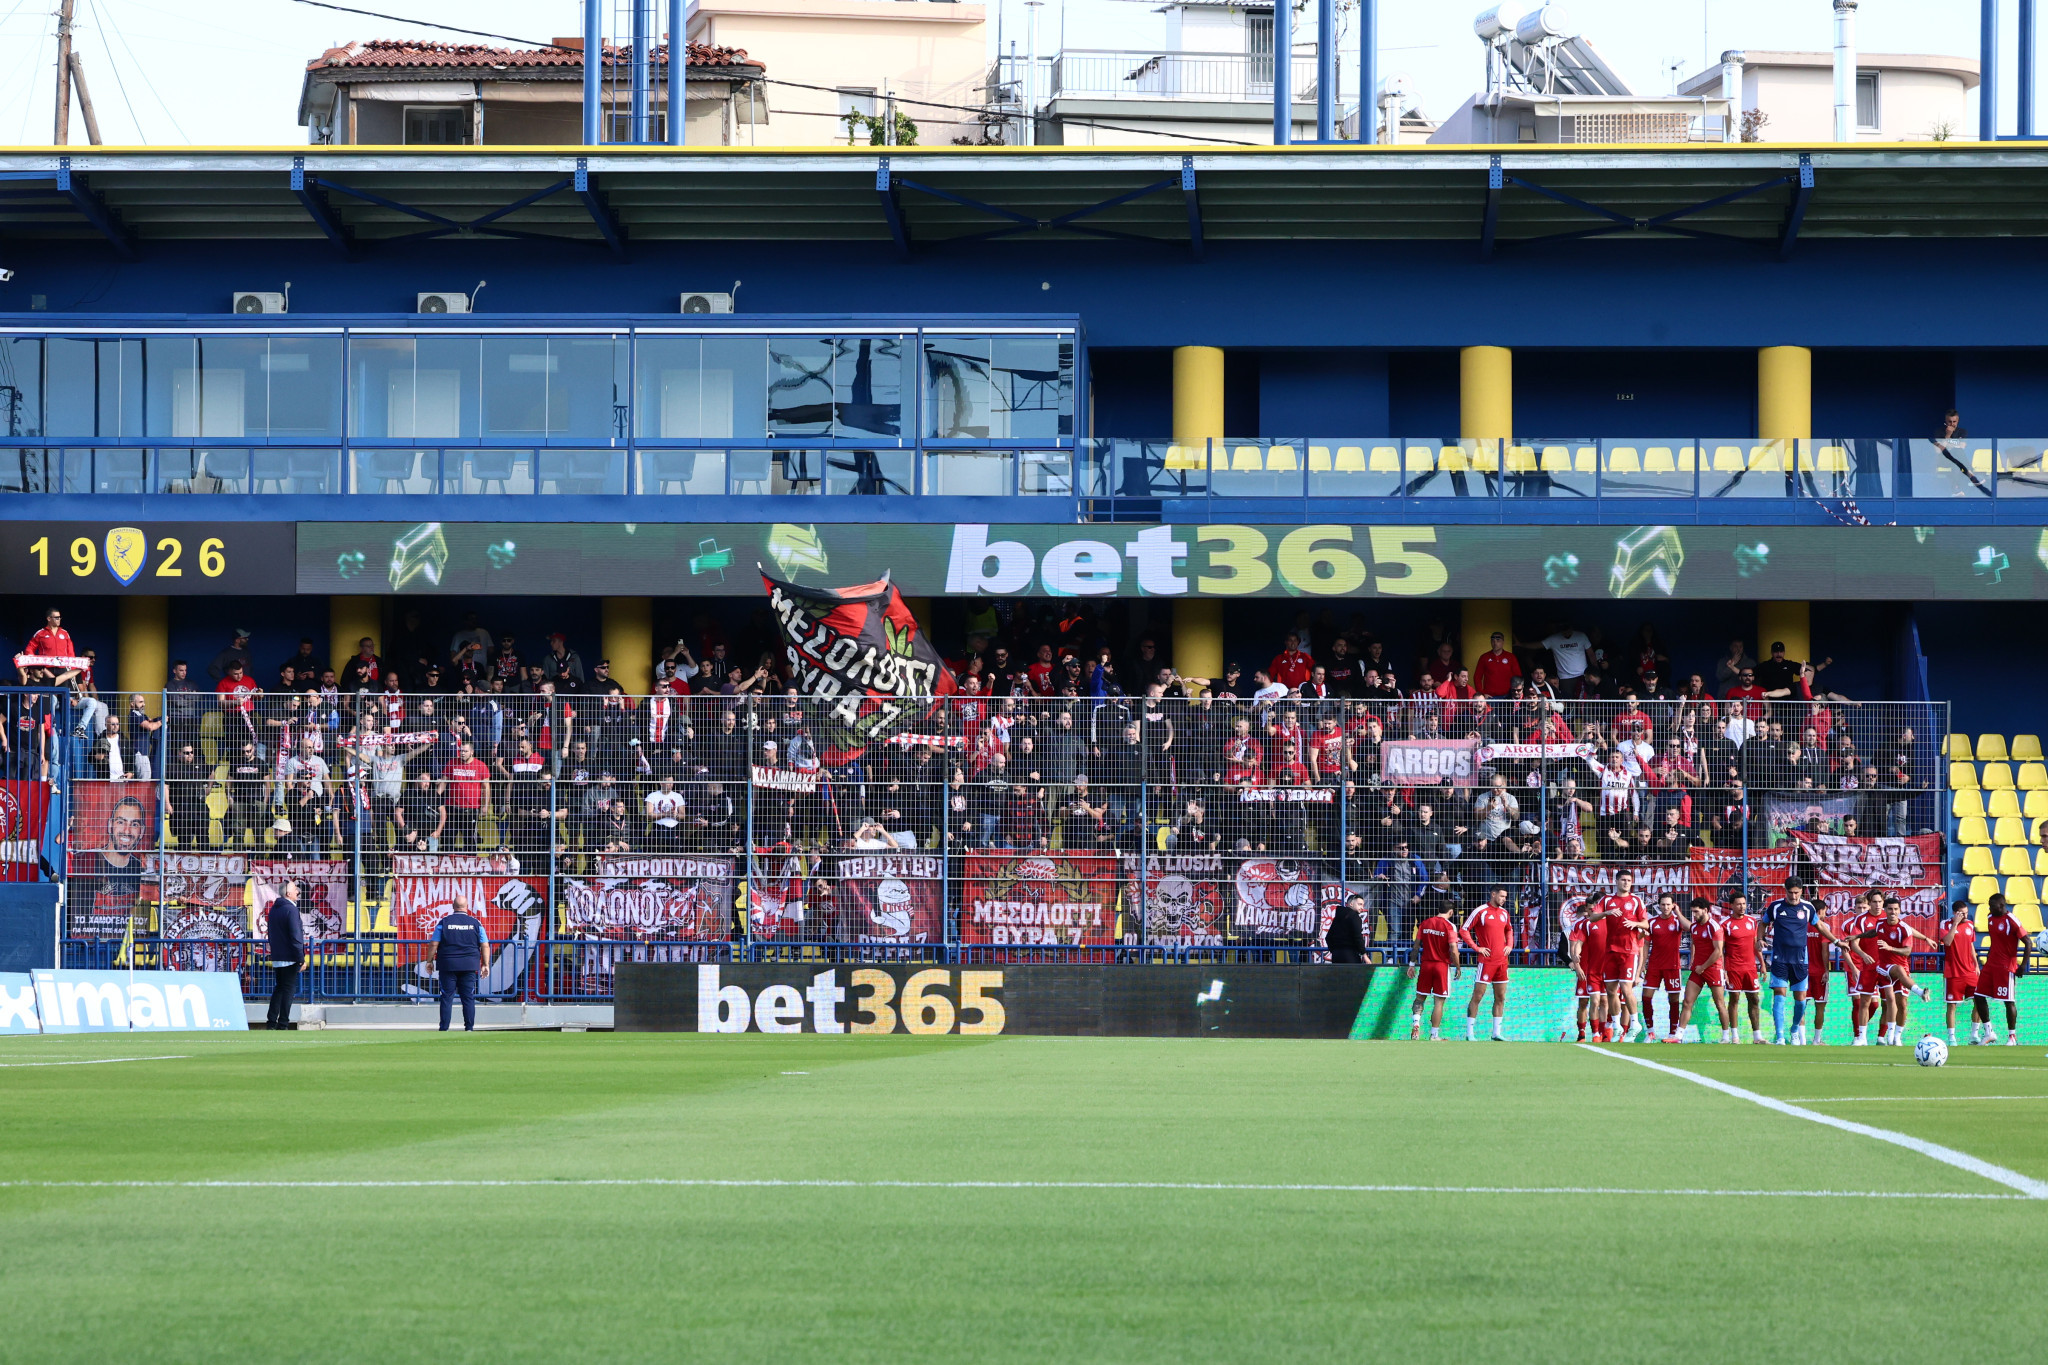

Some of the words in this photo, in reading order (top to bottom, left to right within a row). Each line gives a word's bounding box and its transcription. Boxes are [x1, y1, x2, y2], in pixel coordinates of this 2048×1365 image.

[944, 524, 1448, 596] bet365
[1504, 745, 1554, 753] ARGOS
[1387, 748, 1472, 777] ARGOS
[145, 853, 245, 875] ΓΥΘΕΙΟ
[395, 855, 493, 874] ΠΕΡΑΜΑ
[605, 858, 728, 877] ΑΣΠΡΟΠΥΡΓΟΣ
[838, 856, 944, 879] ΠΕΡΙΣΤΕΡΙ
[1550, 864, 1692, 895] PASAMANI
[973, 900, 1103, 926] ΜΕΣΟΛΟΓΓΙ
[1823, 890, 1936, 918] Moato
[74, 915, 86, 925] ΤΟ
[165, 908, 245, 943] ΕΣΣΑΛΟΝΙΚΗ
[992, 925, 1058, 945] ΘΥΡΑ
[1067, 927, 1082, 945] 7
[1669, 978, 1680, 988] 45
[1997, 986, 2008, 997] 99
[697, 964, 1006, 1035] bet365
[212, 1018, 231, 1029] 21+
